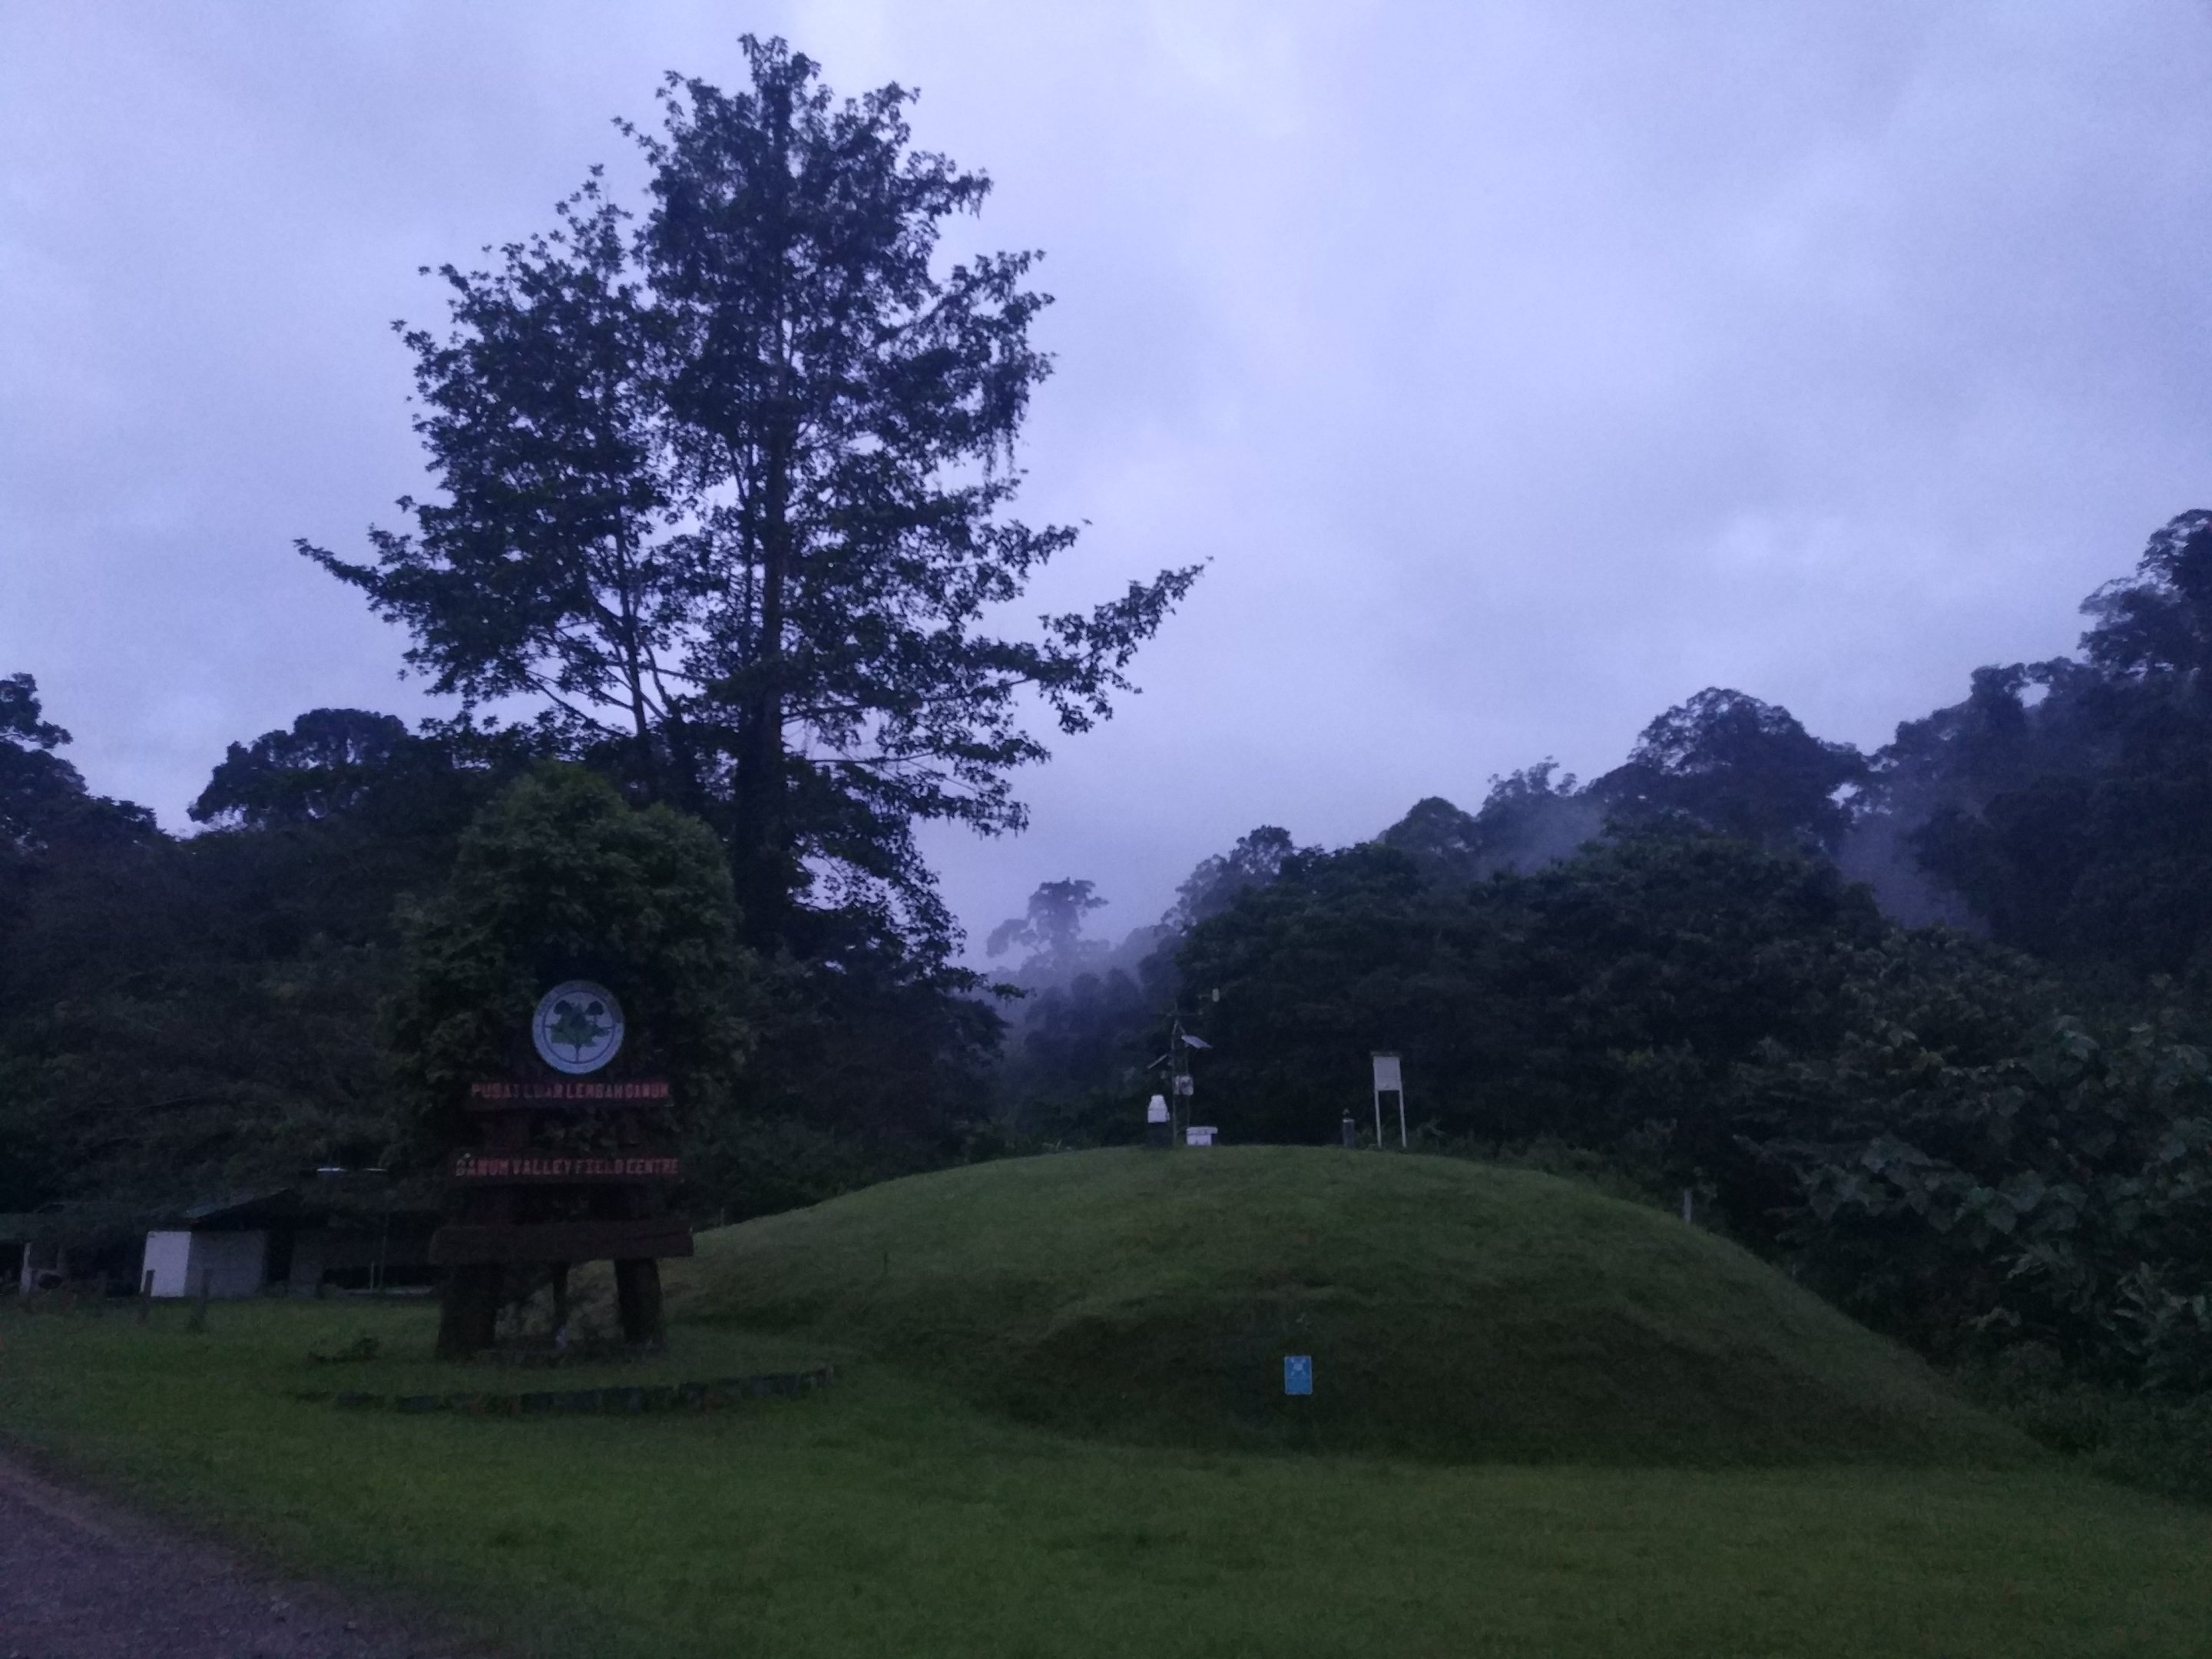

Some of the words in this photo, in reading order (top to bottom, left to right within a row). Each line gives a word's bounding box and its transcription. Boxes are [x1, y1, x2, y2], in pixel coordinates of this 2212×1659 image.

[566, 1083, 623, 1099] LEMBAH
[625, 1083, 669, 1099] DANUM
[455, 1159, 508, 1177] DANUM
[513, 1159, 571, 1175] VALLEY
[575, 1158, 624, 1174] FIELD
[625, 1158, 679, 1175] CENTRE
